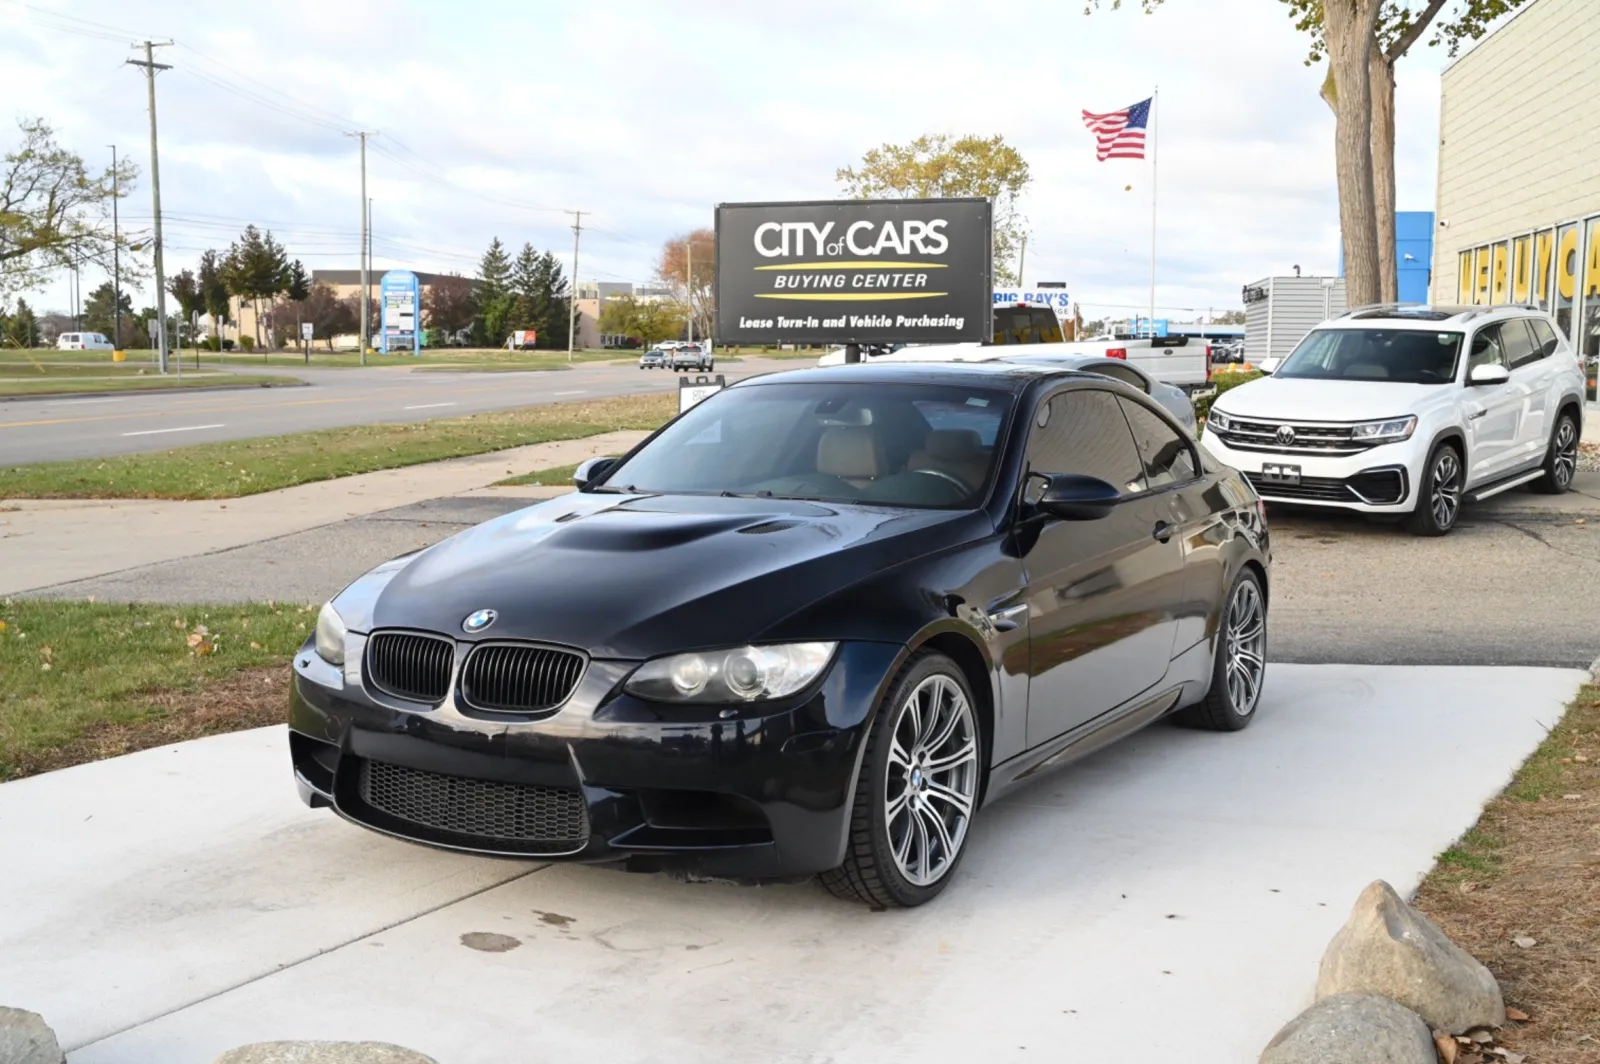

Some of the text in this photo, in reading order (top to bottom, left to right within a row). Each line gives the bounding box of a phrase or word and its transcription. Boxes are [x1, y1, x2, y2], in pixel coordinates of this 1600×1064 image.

[753, 218, 949, 258] CITY of CARS
[773, 273, 928, 290] BUYING CENTER
[739, 313, 965, 331] Lease Turn-In and Vehicle Purchasing
